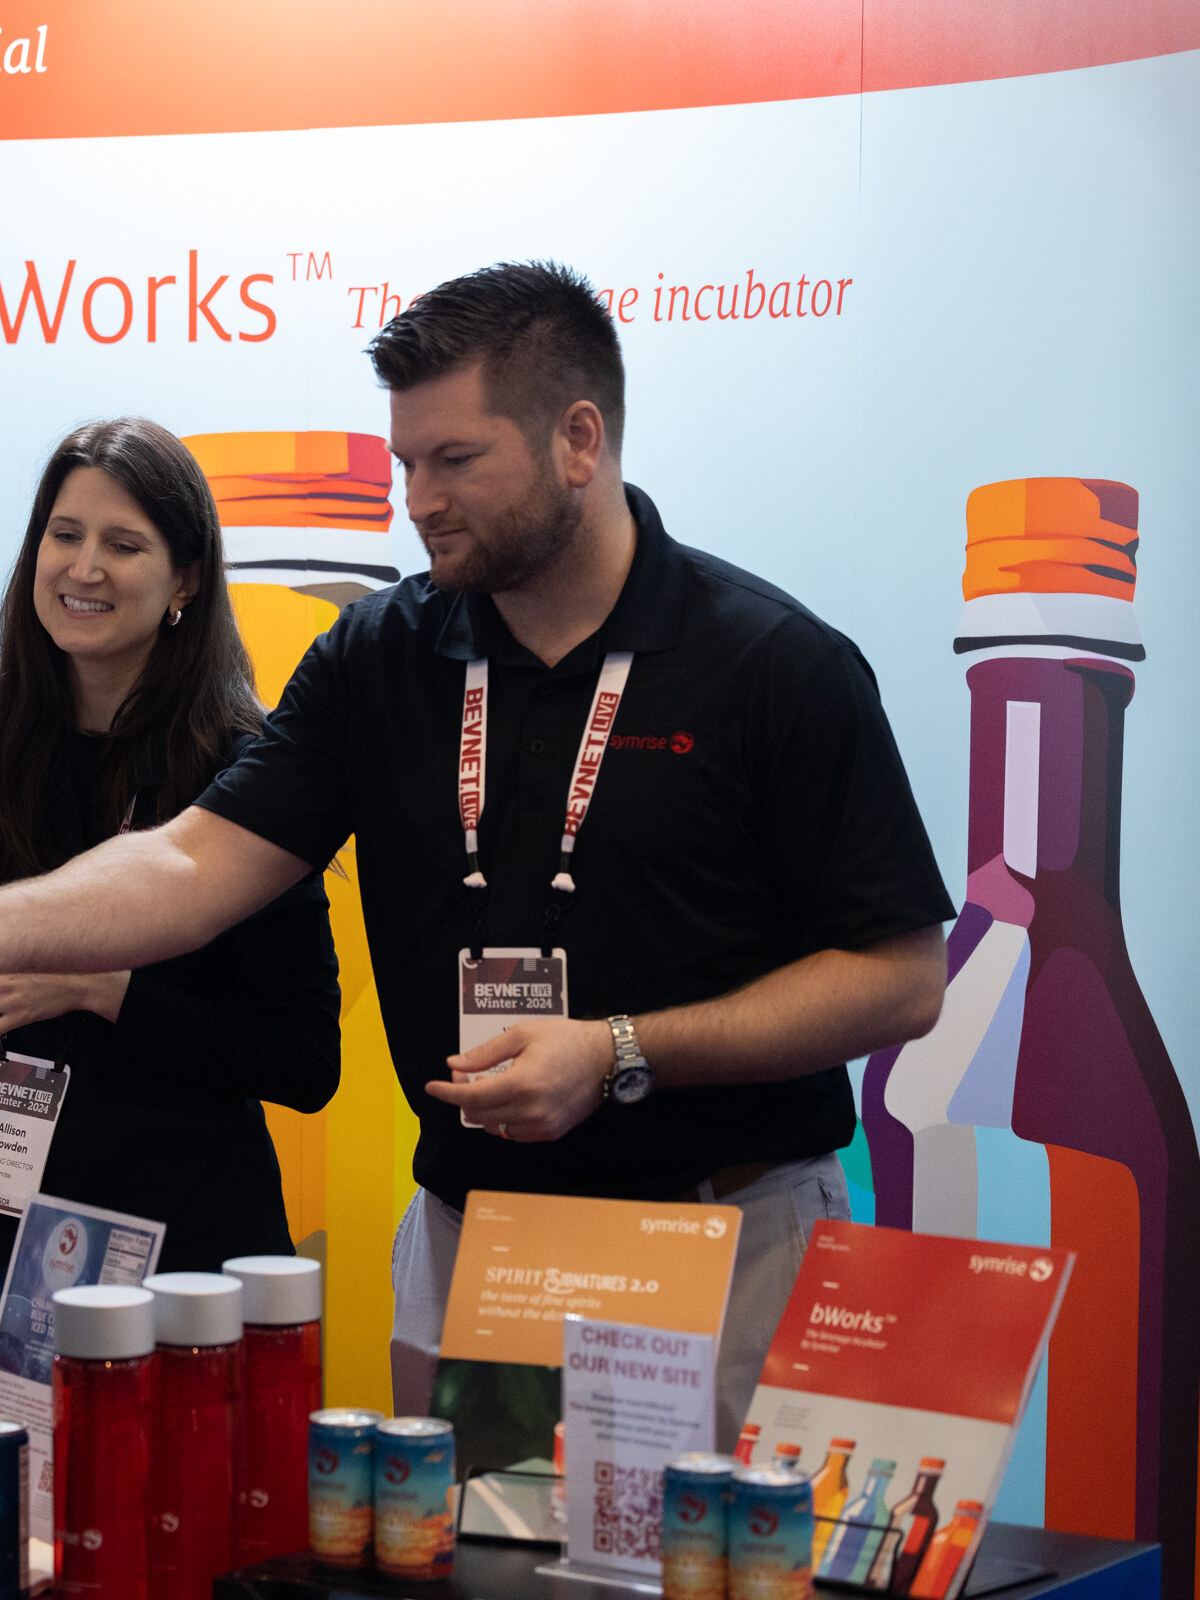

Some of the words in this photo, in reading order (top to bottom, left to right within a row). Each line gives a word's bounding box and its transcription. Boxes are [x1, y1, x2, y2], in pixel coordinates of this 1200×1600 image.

[653, 268, 853, 322] incubator
[609, 733, 667, 750] symrise
[475, 997, 517, 1009] Winter
[526, 998, 552, 1009] 2024
[27, 1101, 49, 1114] 2024
[6, 1159, 33, 1172] DIRECTOR
[640, 1215, 701, 1236] symrise
[969, 1255, 1027, 1275] symrise
[484, 1267, 543, 1287] SPIRIT
[629, 1279, 659, 1293] 2.0
[581, 1326, 648, 1351] CHECK
[651, 1336, 690, 1357] OUT
[569, 1352, 610, 1374] OUR
[614, 1360, 659, 1381] NEW
[662, 1367, 700, 1388] SITE
